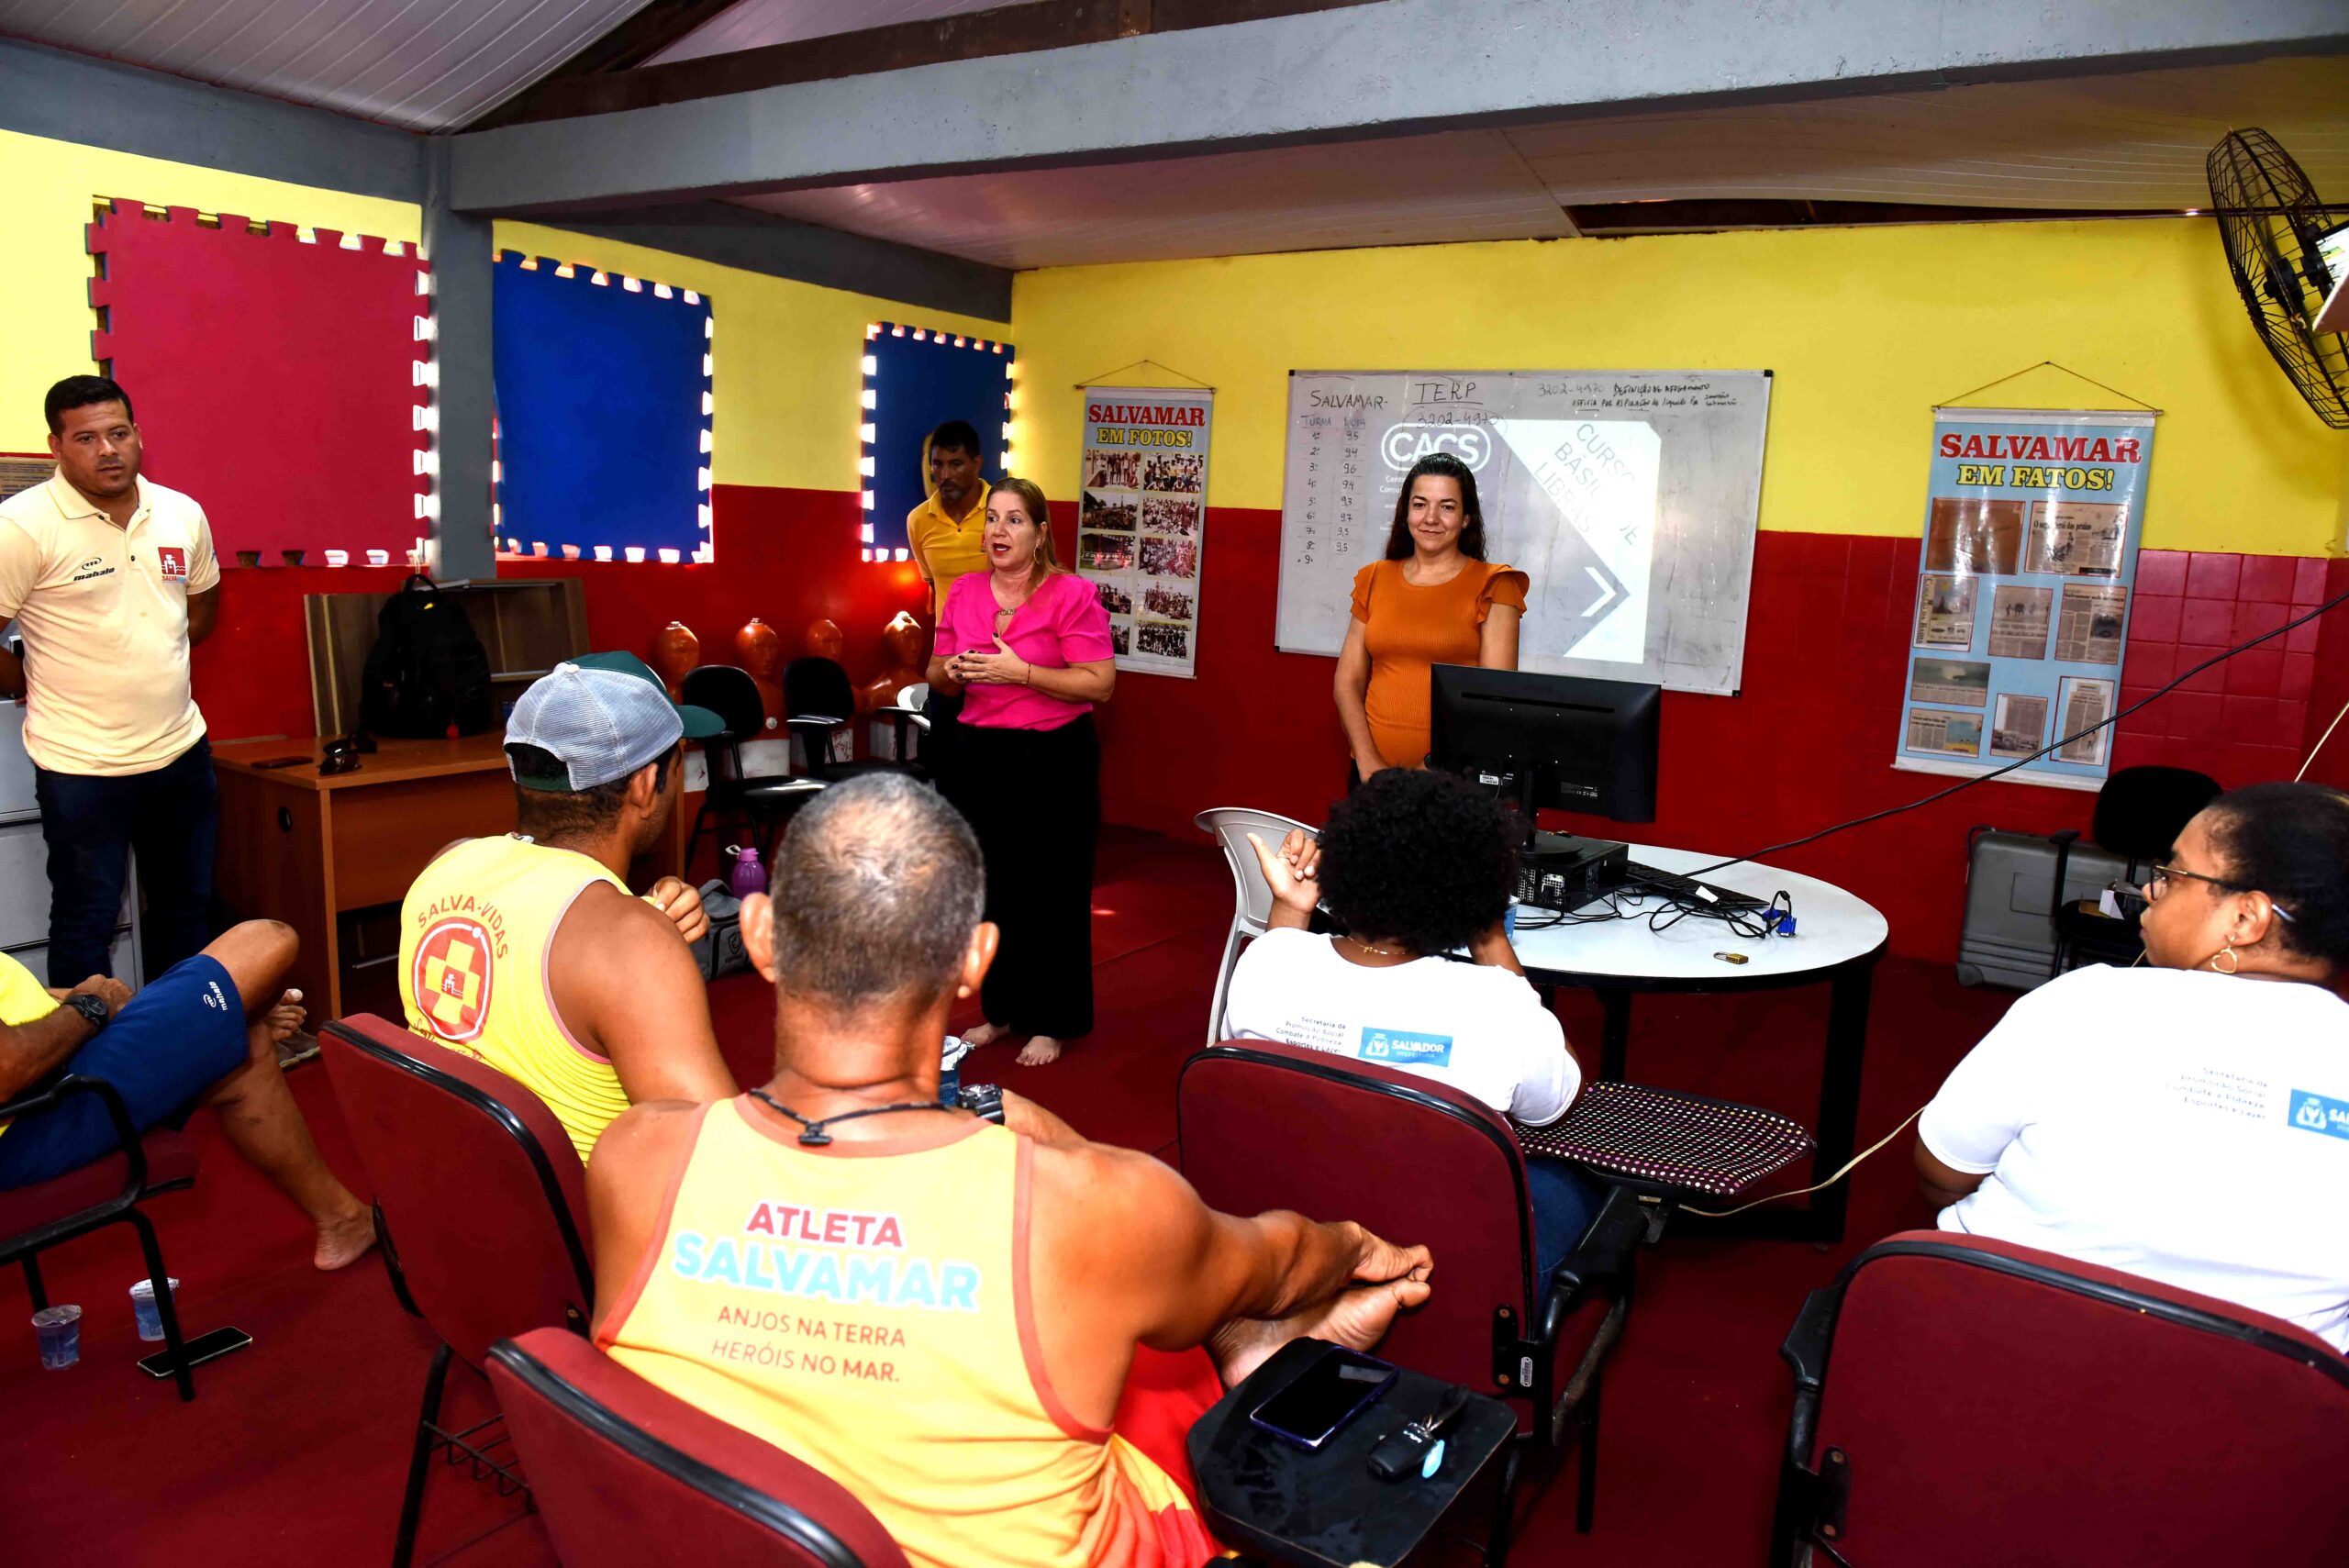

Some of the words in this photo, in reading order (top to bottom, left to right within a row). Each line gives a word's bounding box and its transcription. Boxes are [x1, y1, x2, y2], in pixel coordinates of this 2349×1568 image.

[1414, 382, 1476, 403] TERP
[1088, 404, 1205, 427] SALVAMAR
[1097, 428, 1125, 444] EM
[1129, 428, 1193, 447] FOTOS!
[1389, 431, 1479, 464] CACS
[1940, 433, 2142, 463] SALVAMAR
[1956, 463, 2005, 486] EM
[2010, 466, 2114, 490] FATOS!
[417, 895, 508, 959] SALVA-VIDAS
[1275, 1027, 1303, 1039] Combate
[1301, 1016, 1335, 1028] Secretaria
[1286, 1038, 1313, 1050] Esportes
[1392, 1040, 1444, 1053] SALVADOR
[746, 1202, 903, 1248] ATLETA
[674, 1232, 978, 1309] SALVAMAR
[718, 1306, 790, 1334] ANJOS
[796, 1318, 827, 1340] NA
[833, 1322, 907, 1348] TERRA
[710, 1339, 795, 1369] HERÓIS
[801, 1355, 836, 1374] NO
[842, 1358, 901, 1383] MAR.
